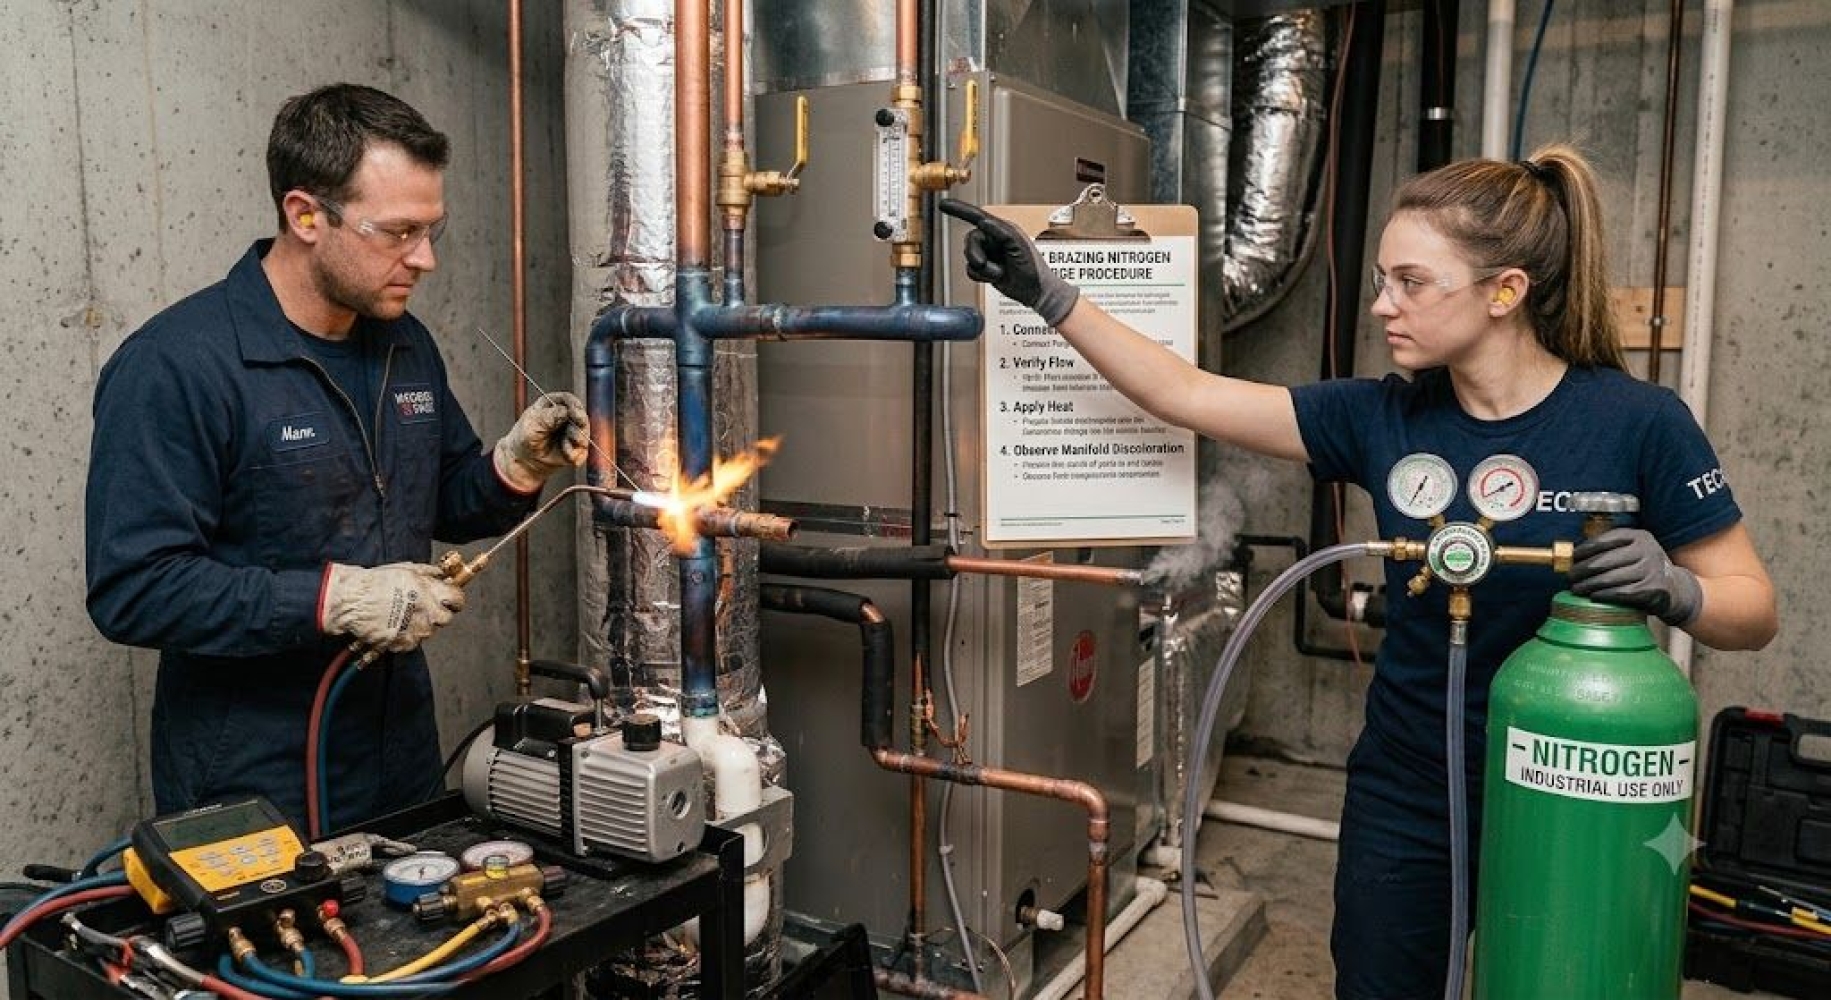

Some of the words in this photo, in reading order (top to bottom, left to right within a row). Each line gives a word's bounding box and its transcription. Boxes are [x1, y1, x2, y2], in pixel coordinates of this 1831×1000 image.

[1049, 251, 1104, 264] BRAZING
[1107, 251, 1171, 264] NITROGEN
[1079, 267, 1153, 280] PROCEDURE
[999, 325, 1010, 336] 1.
[999, 357, 1010, 369] 2.
[1013, 356, 1045, 371] Verify
[1049, 356, 1075, 369] Flow
[999, 401, 1010, 413] 3.
[1013, 401, 1045, 415] Apply
[1047, 400, 1074, 413] Heat
[1000, 445, 1010, 457] 4.
[1013, 444, 1059, 457] Observe
[1061, 443, 1110, 456] Manifold
[1112, 442, 1185, 455] Discoloration
[1531, 738, 1675, 778] NITROGEN
[1520, 767, 1612, 797] INDUSTRIAL
[1617, 782, 1648, 798] USE
[1651, 779, 1684, 798] ONLY
